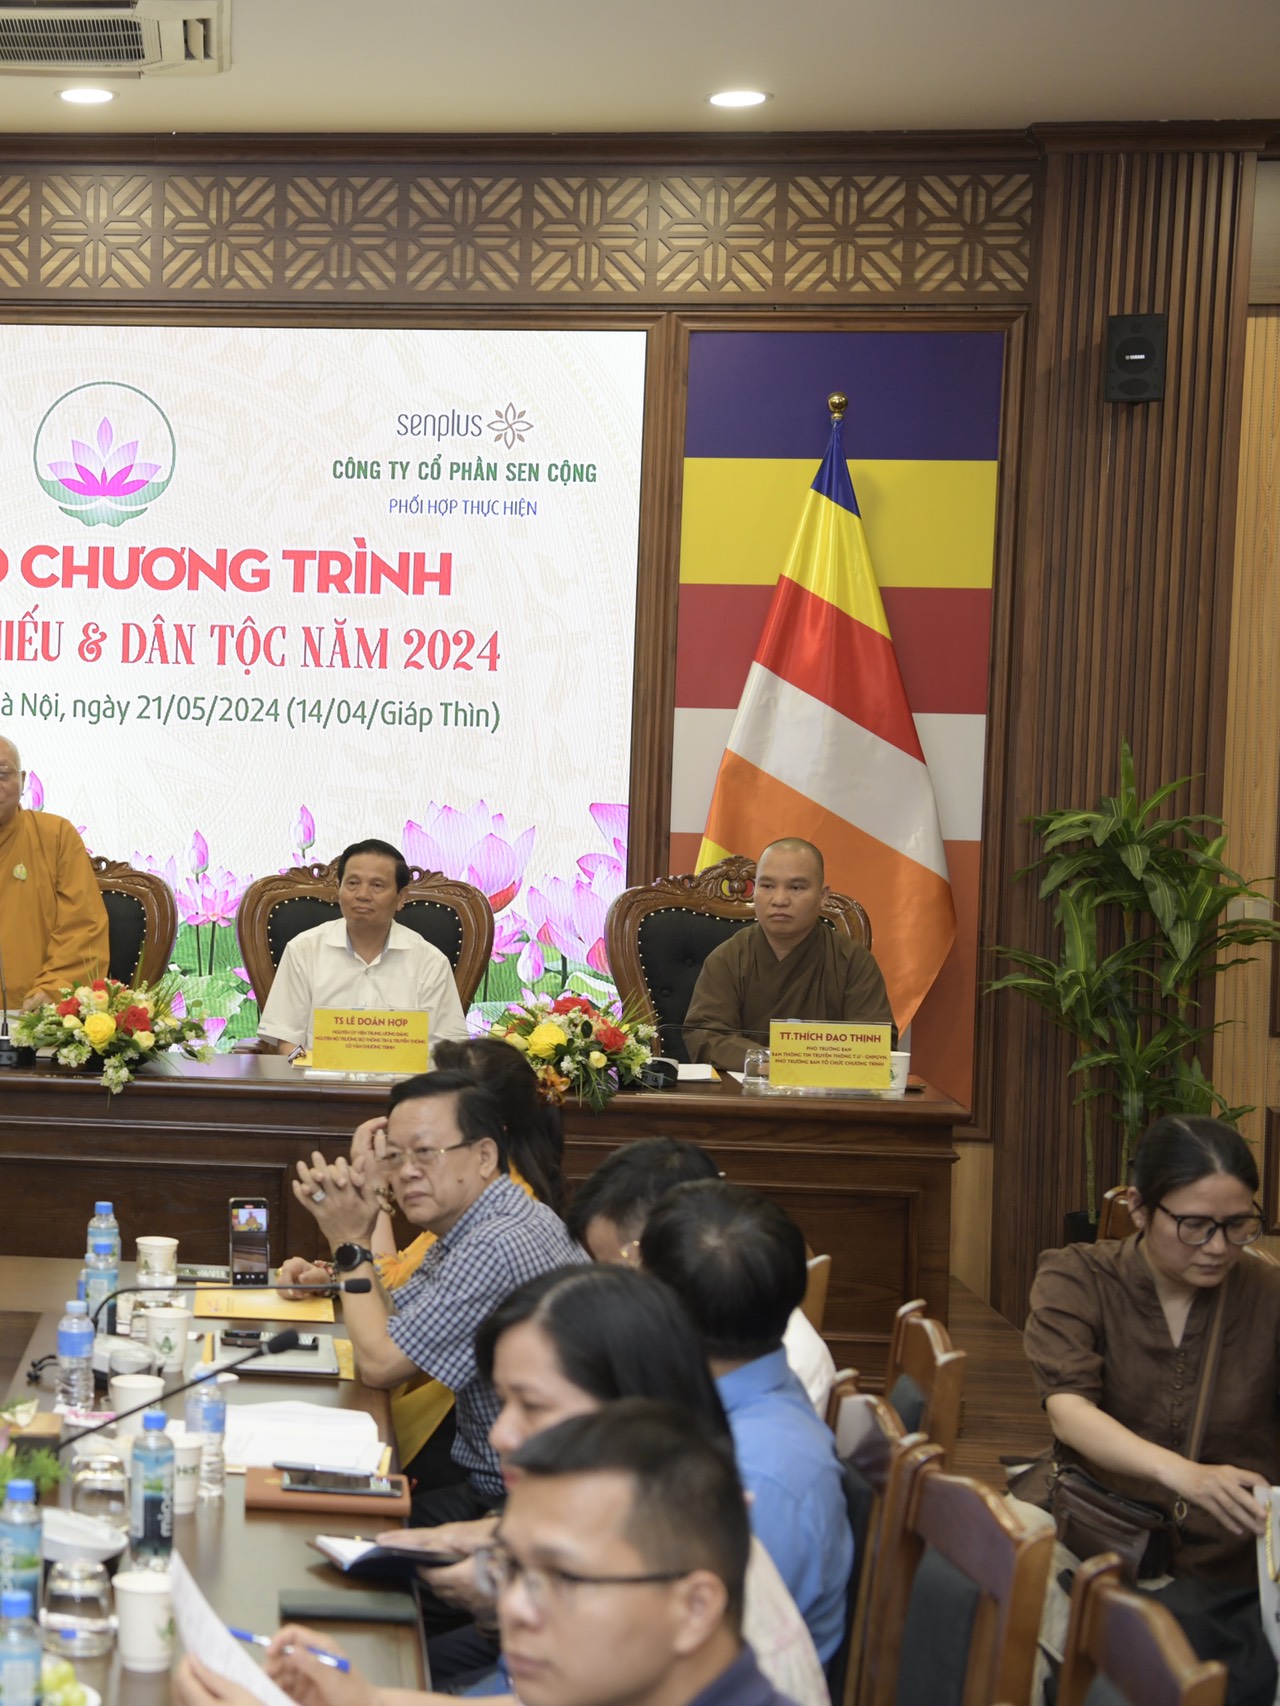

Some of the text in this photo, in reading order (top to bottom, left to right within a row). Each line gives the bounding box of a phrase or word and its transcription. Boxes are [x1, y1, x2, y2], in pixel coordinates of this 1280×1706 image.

[396, 408, 482, 442] senplus
[332, 454, 597, 486] CÔNG TY CỔ PHẦN SEN CỘNG
[389, 494, 537, 518] PHỐI HỢP THỰC HIỆN
[20, 545, 270, 593] CHƯƠNG
[282, 537, 452, 596] TRÌNH
[78, 622, 108, 663] &
[121, 613, 196, 666] DÂN
[210, 615, 286, 676] TỘC
[300, 617, 389, 669] NĂM
[403, 628, 501, 672] 2024
[20, 693, 66, 723] Nội,
[73, 695, 130, 726] ngày
[136, 694, 280, 726] 21/05/2024
[287, 696, 433, 732] (14/04/Giáp
[440, 700, 501, 734] Thìn)
[334, 1016, 343, 1025] TS
[346, 1015, 355, 1025] LÊ
[388, 1018, 408, 1028] HỢP
[779, 1030, 881, 1044] TT.THÍCH ĐẠO THỊNH
